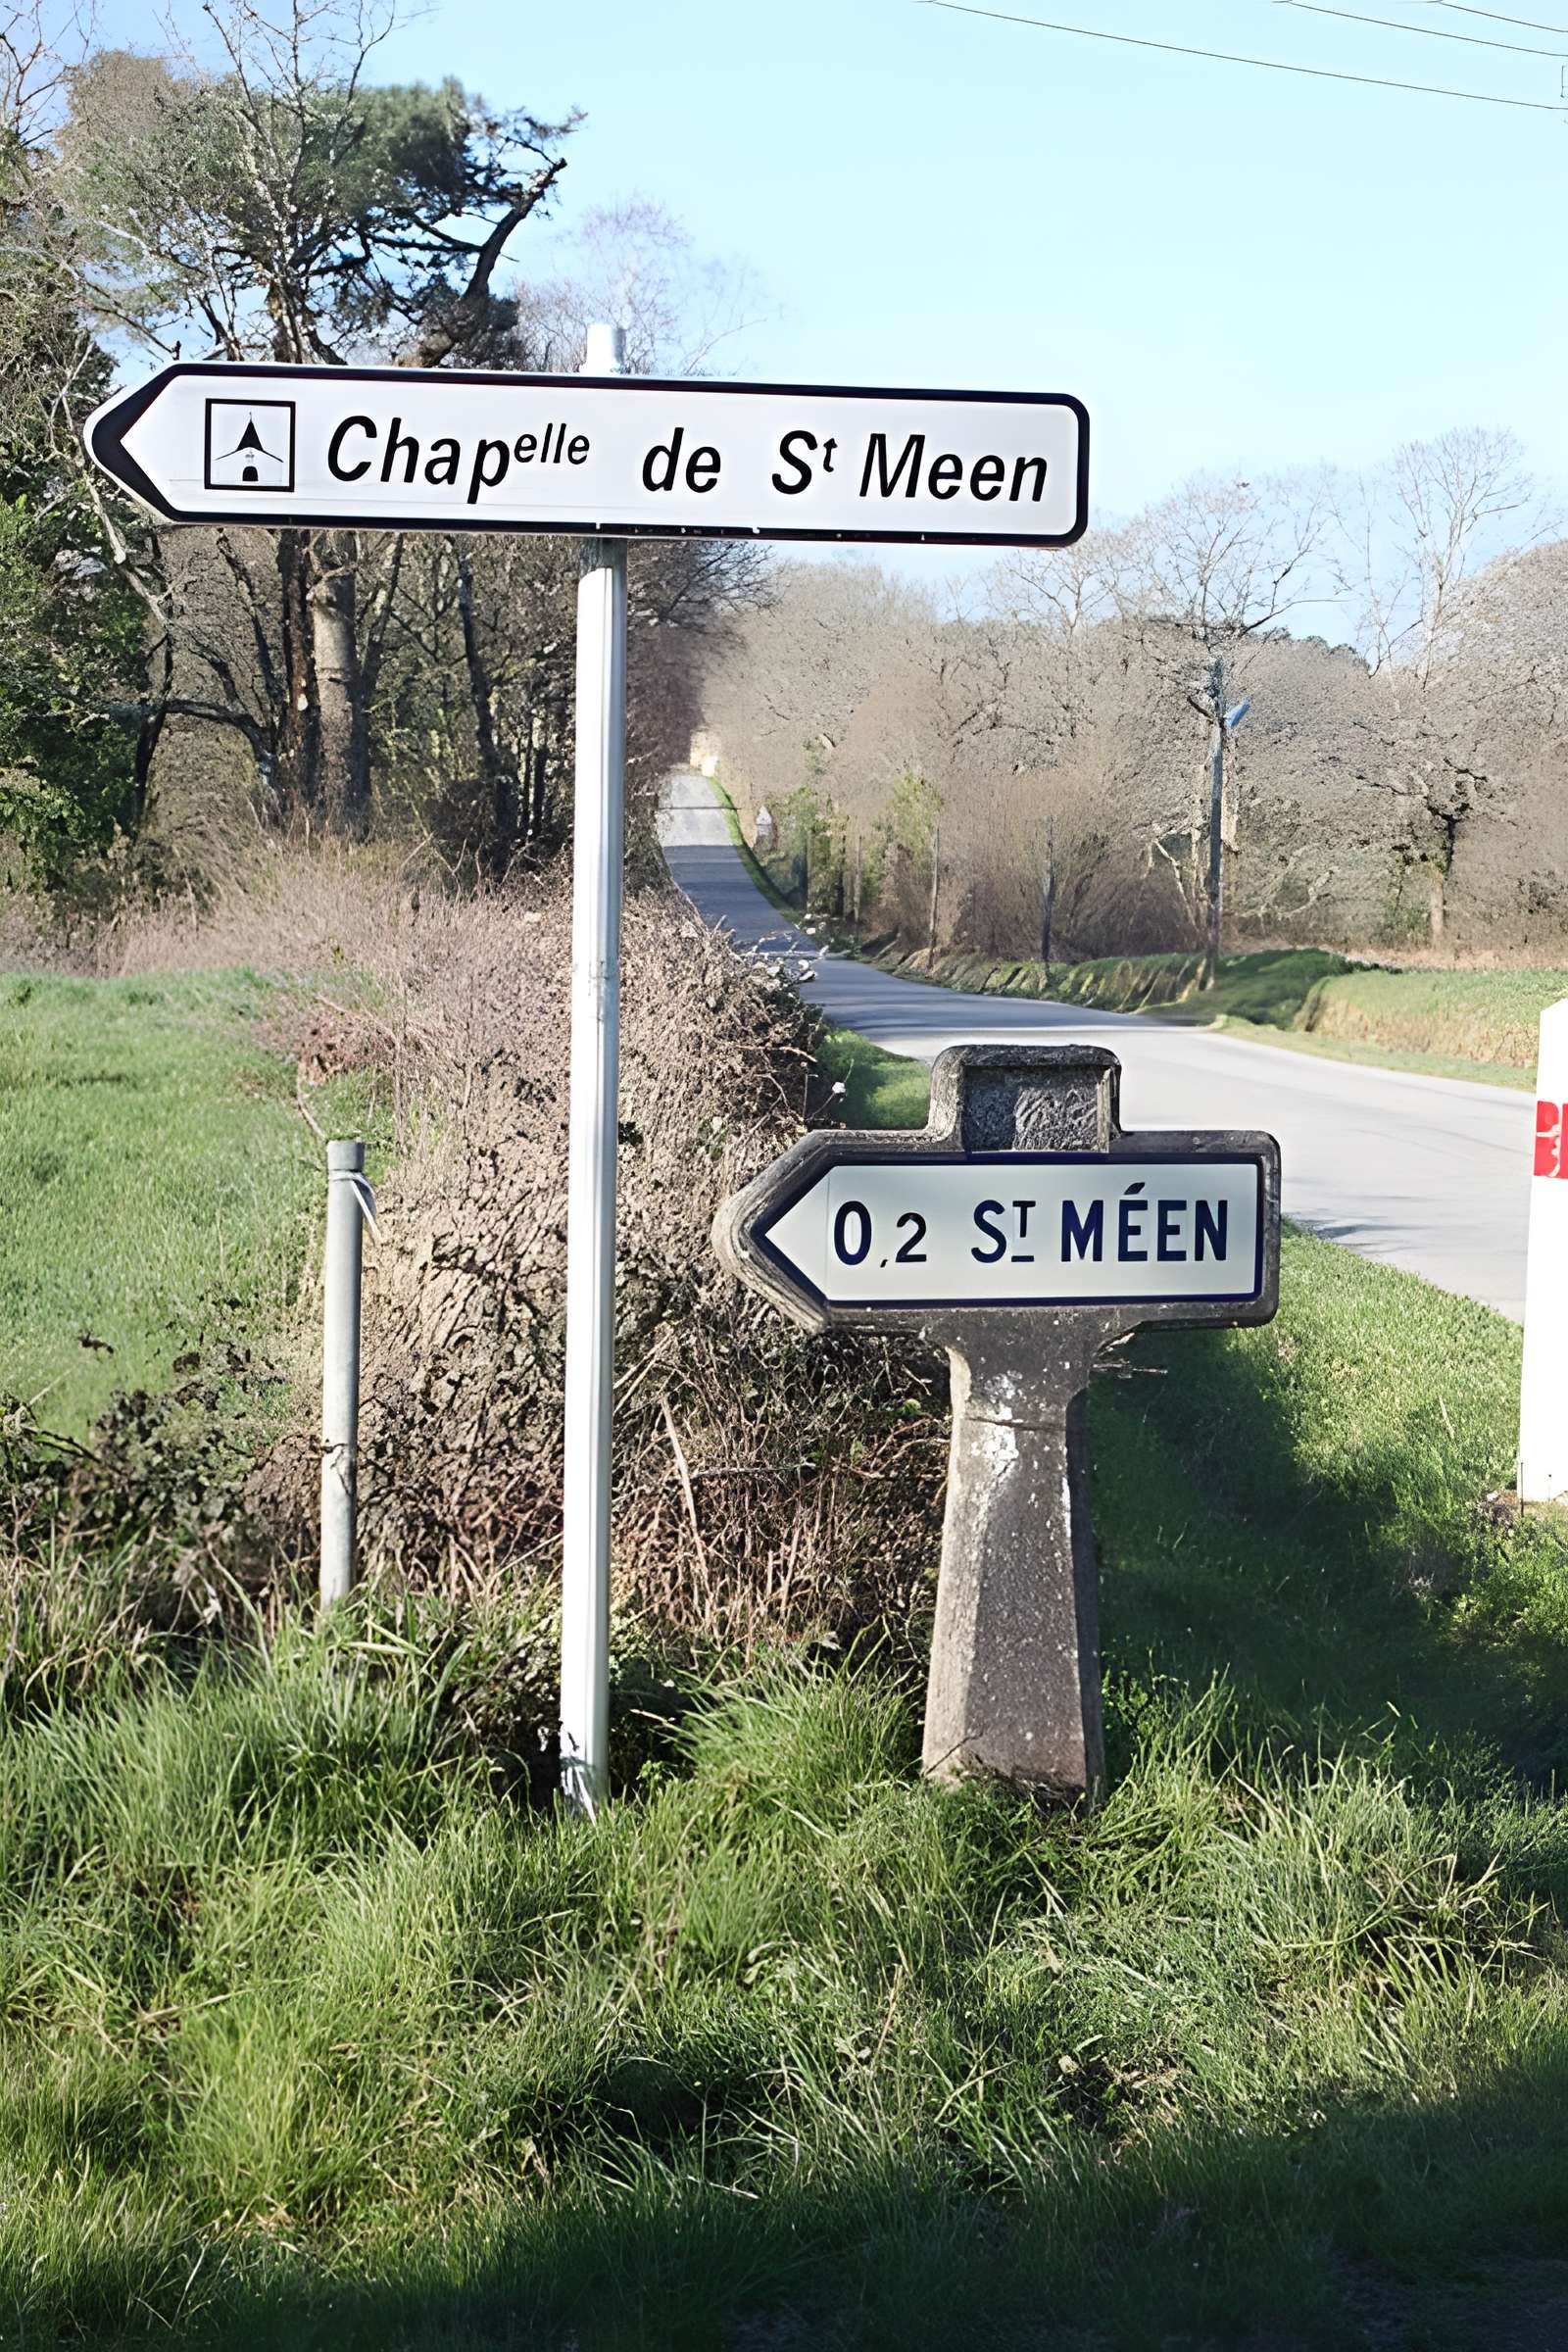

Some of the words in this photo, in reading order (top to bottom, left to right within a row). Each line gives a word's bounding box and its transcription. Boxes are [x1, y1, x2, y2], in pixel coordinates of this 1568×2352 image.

[326, 415, 590, 505] Chapelle
[642, 426, 721, 494] de
[771, 429, 838, 495] St
[858, 432, 1049, 503] Meen
[833, 1200, 928, 1268] 0,2
[1060, 1181, 1228, 1263] MÉEN
